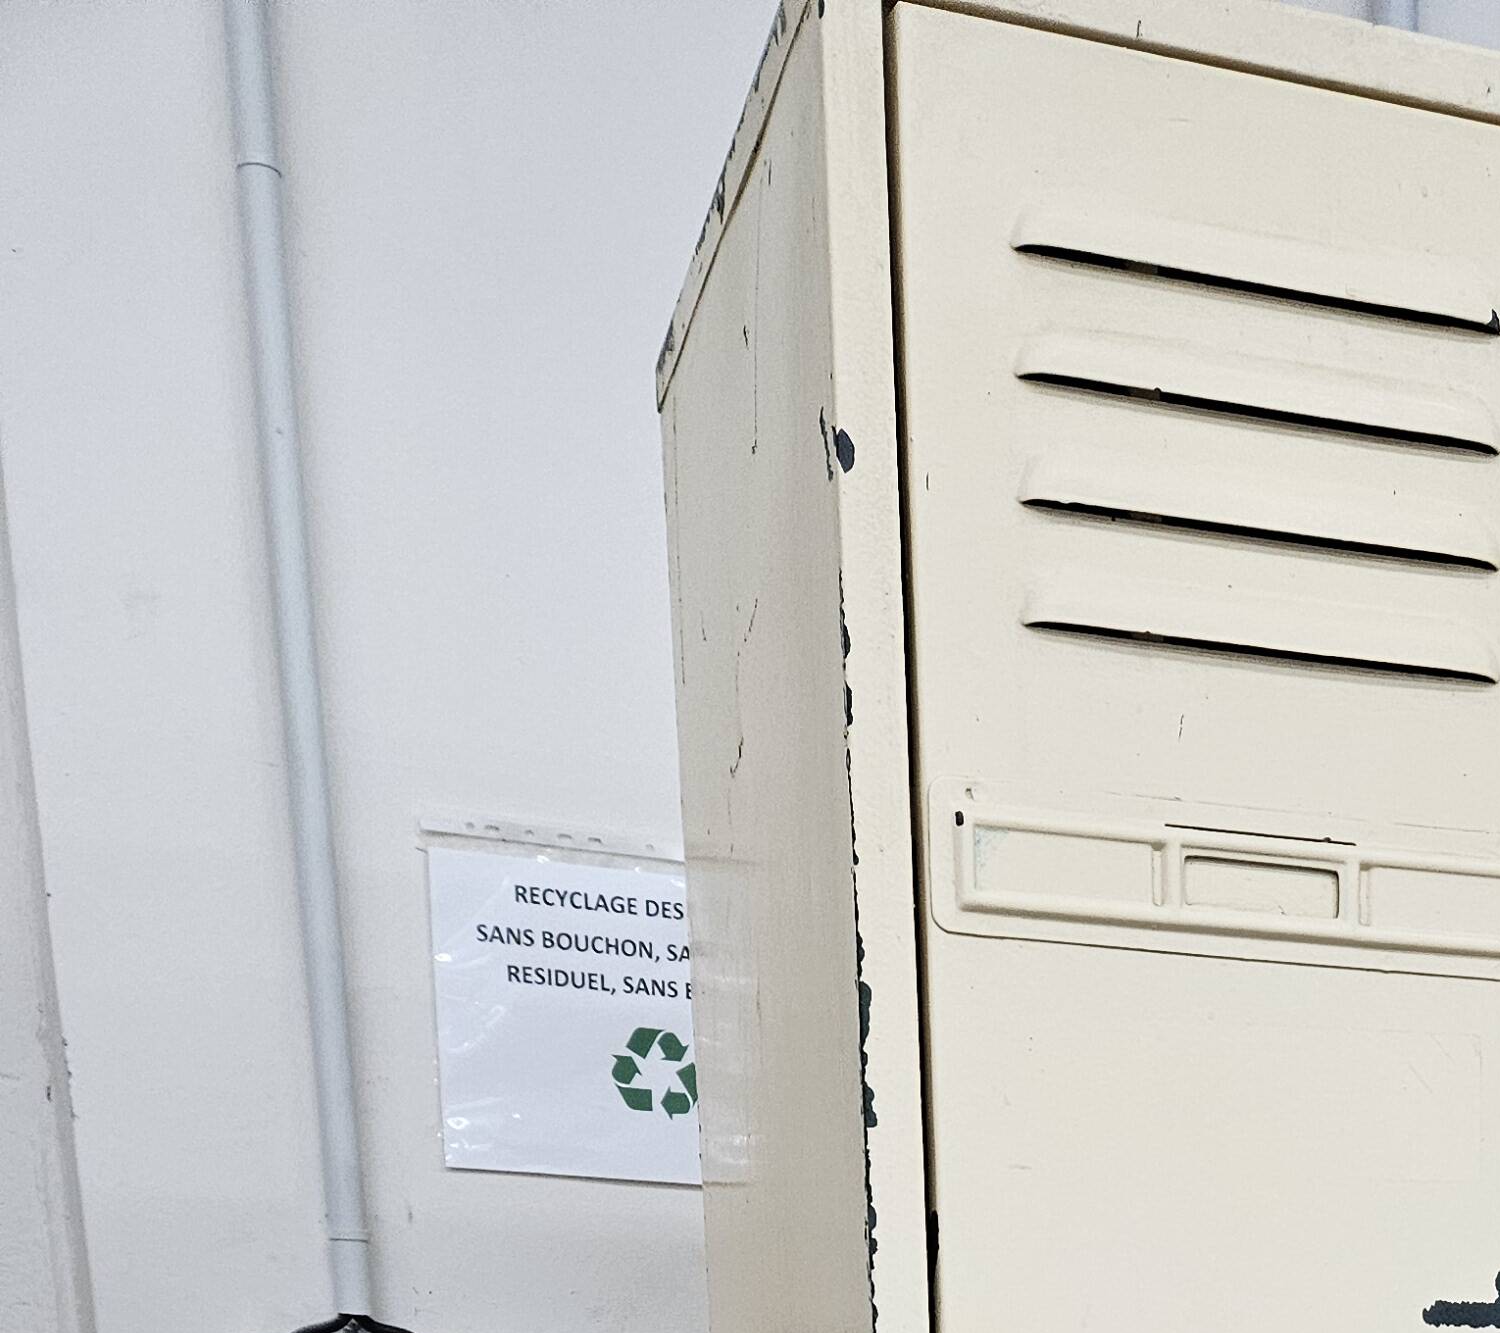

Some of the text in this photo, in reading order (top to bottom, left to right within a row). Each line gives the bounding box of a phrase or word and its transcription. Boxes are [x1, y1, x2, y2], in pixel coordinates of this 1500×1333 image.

[515, 885, 685, 921] RECYCLAGE DES
[476, 924, 535, 947] SANS
[542, 930, 661, 963] BOUCHON,
[507, 965, 617, 996] RESIDUEL,
[623, 976, 679, 998] SANS
